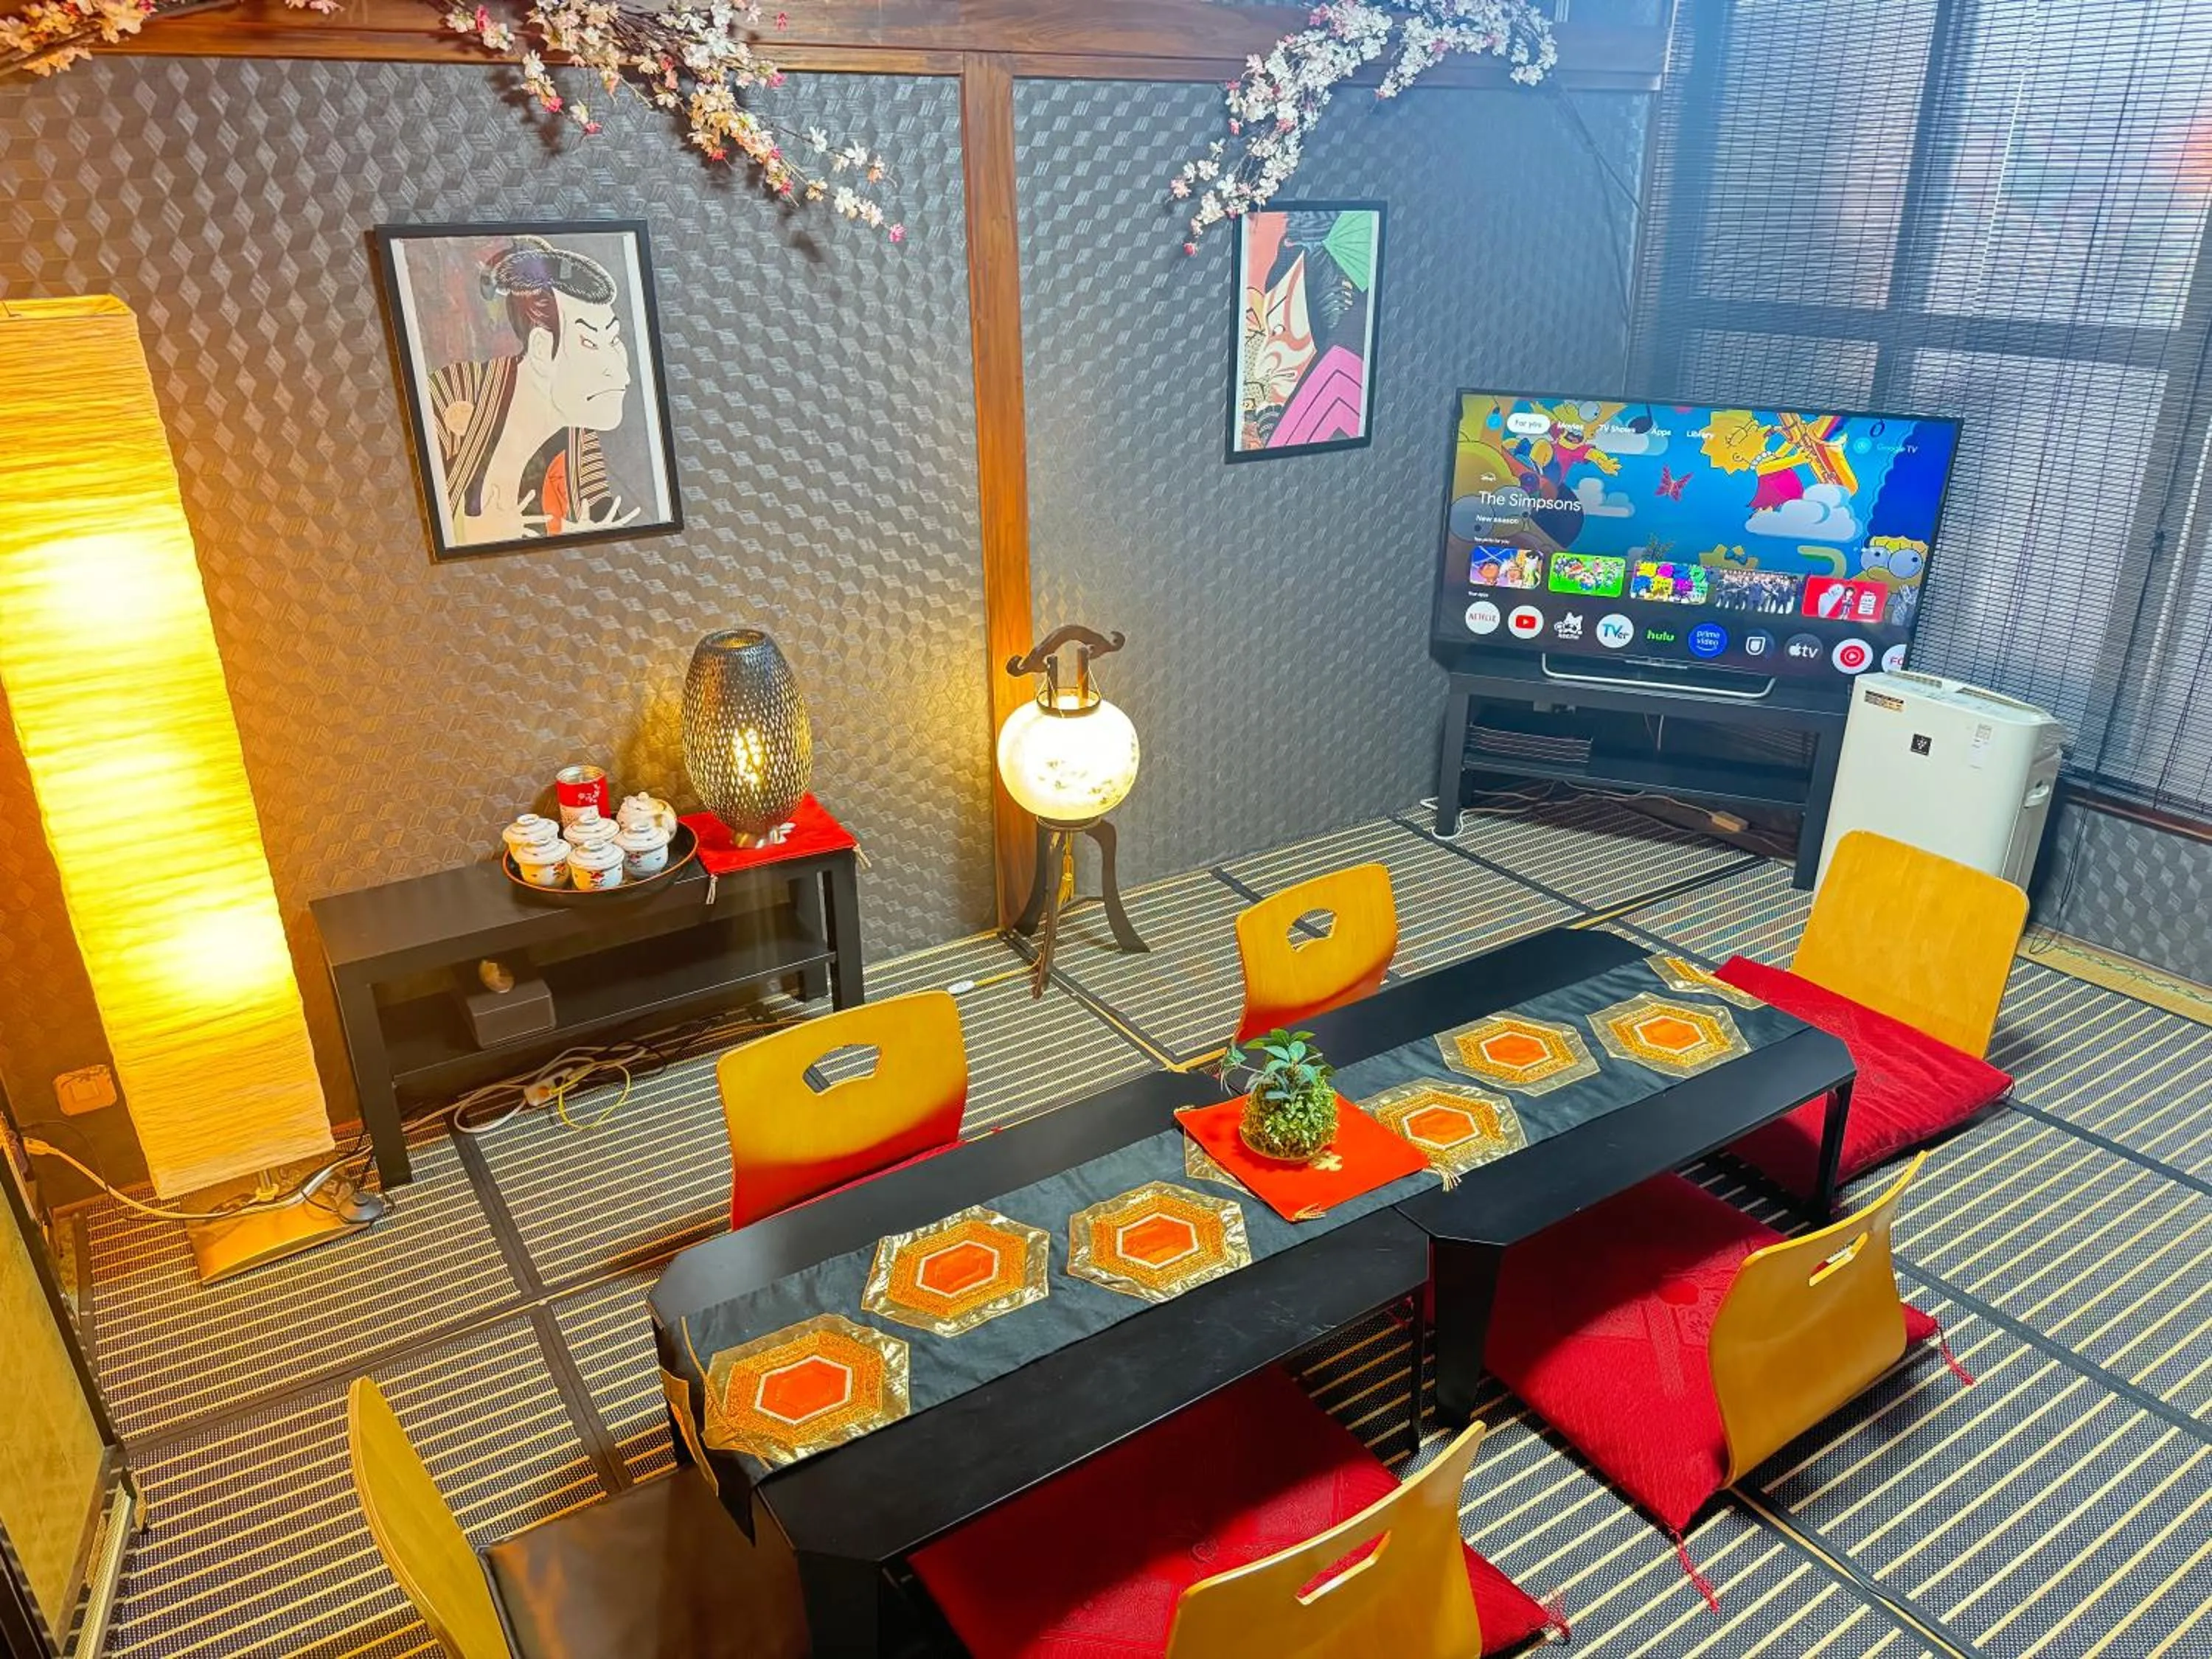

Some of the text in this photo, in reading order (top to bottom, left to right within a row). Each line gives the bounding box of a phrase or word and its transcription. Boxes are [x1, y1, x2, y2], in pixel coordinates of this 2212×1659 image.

[1514, 419, 1527, 427] For
[1651, 428, 1672, 437] Apps
[1686, 430, 1715, 439] Library
[1906, 445, 1918, 453] TV
[1478, 490, 1582, 512] The Simpsons
[1601, 623, 1630, 640] TVer
[1646, 629, 1675, 641] hulu
[1697, 630, 1720, 639] prime
[1801, 645, 1819, 658] tv
